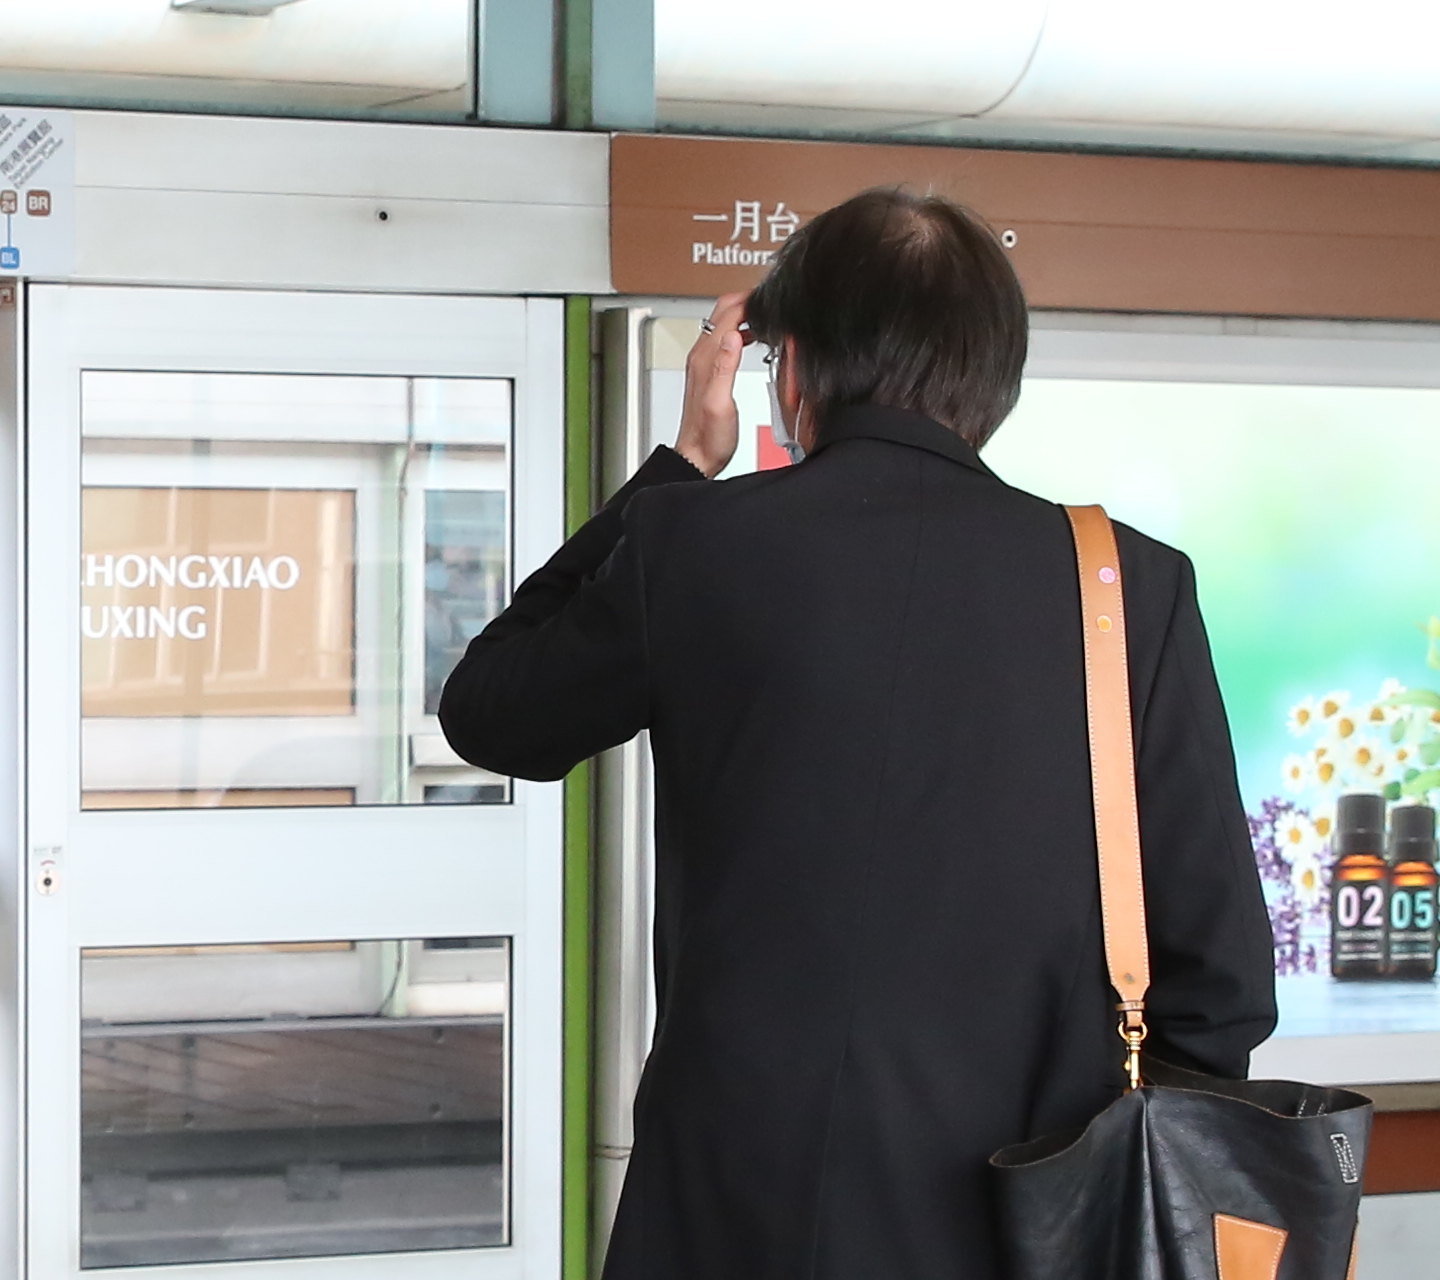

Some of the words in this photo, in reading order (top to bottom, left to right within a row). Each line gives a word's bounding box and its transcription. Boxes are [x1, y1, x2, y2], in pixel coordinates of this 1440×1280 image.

[28, 195, 49, 211] BR
[693, 200, 800, 243] 一月台
[0, 251, 18, 265] BL
[81, 554, 300, 590] HONGXIAO
[1337, 884, 1384, 928] 02
[1390, 890, 1434, 930] 05
